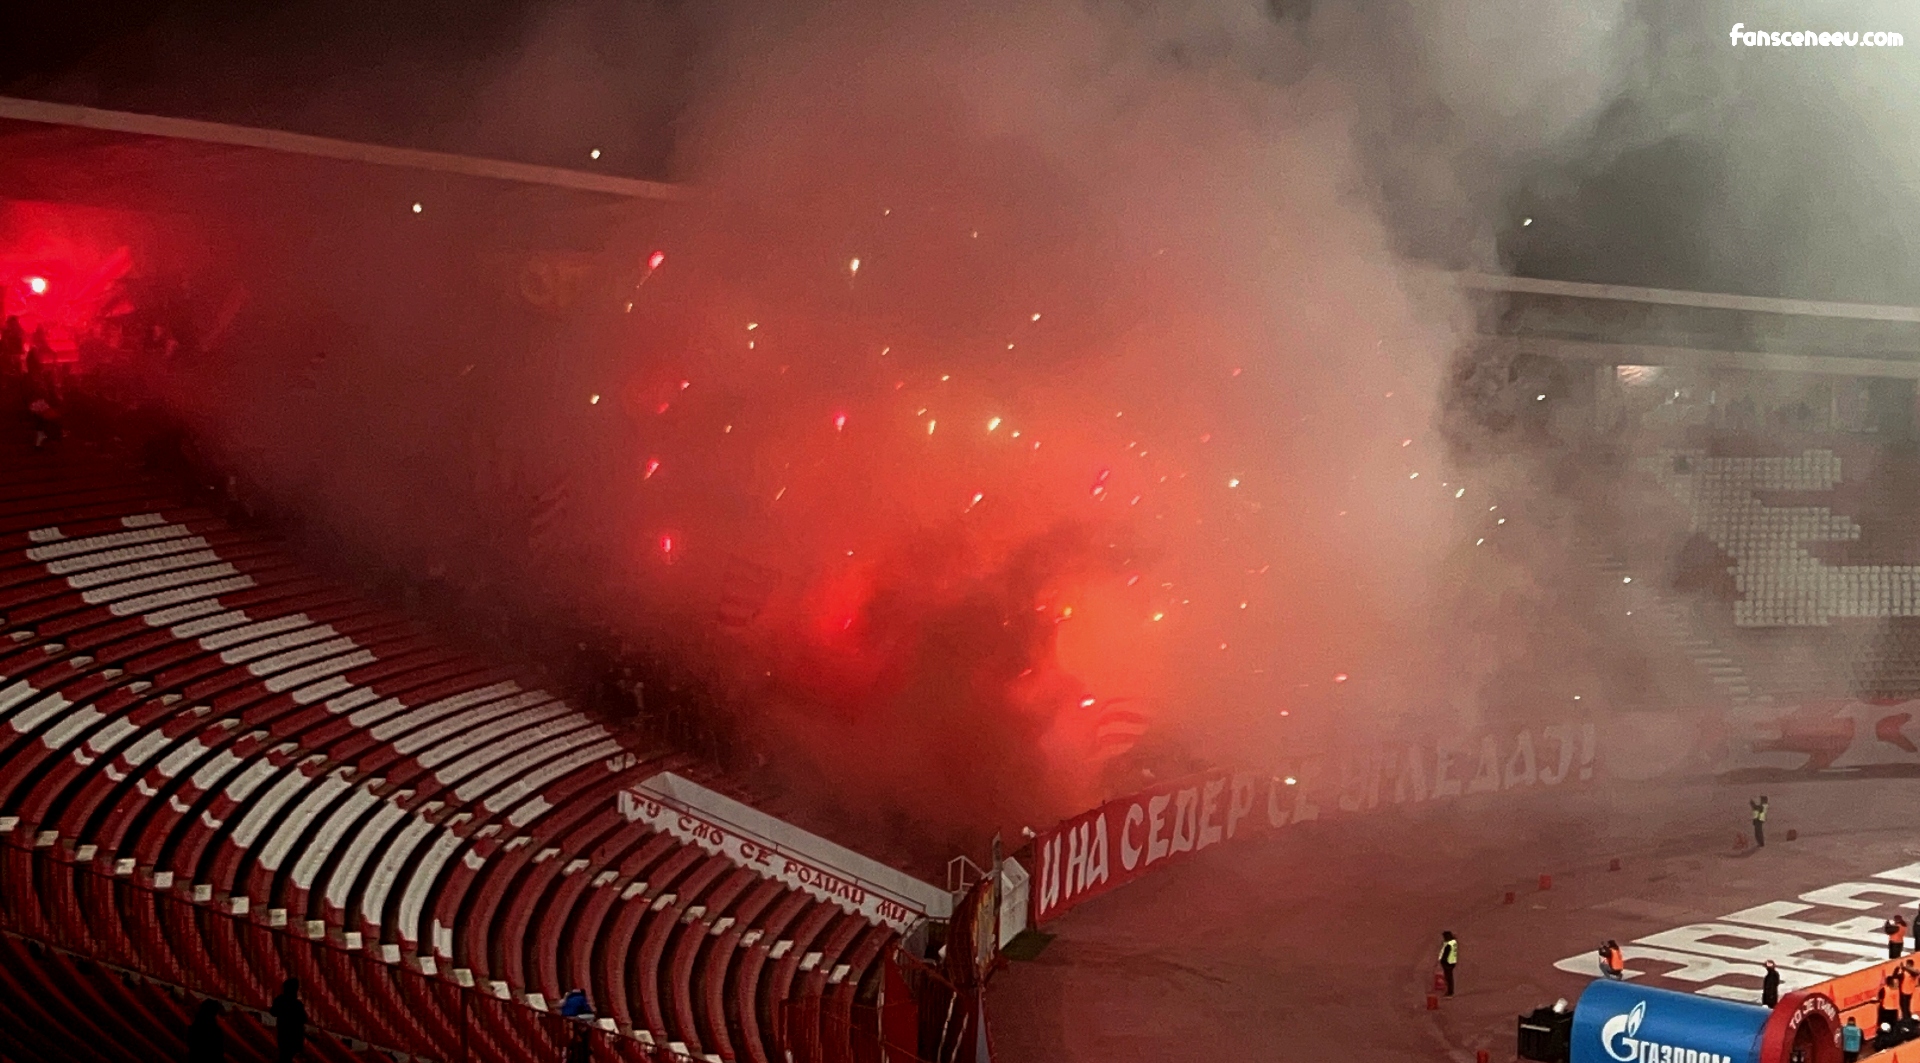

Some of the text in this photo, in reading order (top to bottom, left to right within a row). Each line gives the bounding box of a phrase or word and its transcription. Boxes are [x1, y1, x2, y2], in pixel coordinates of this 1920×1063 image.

[631, 797, 661, 819] ТУ
[678, 815, 724, 846] СМО
[740, 842, 771, 867] СЕ
[783, 861, 866, 905] РОДИЛИ
[1639, 1040, 1732, 1063] ГАЗП
